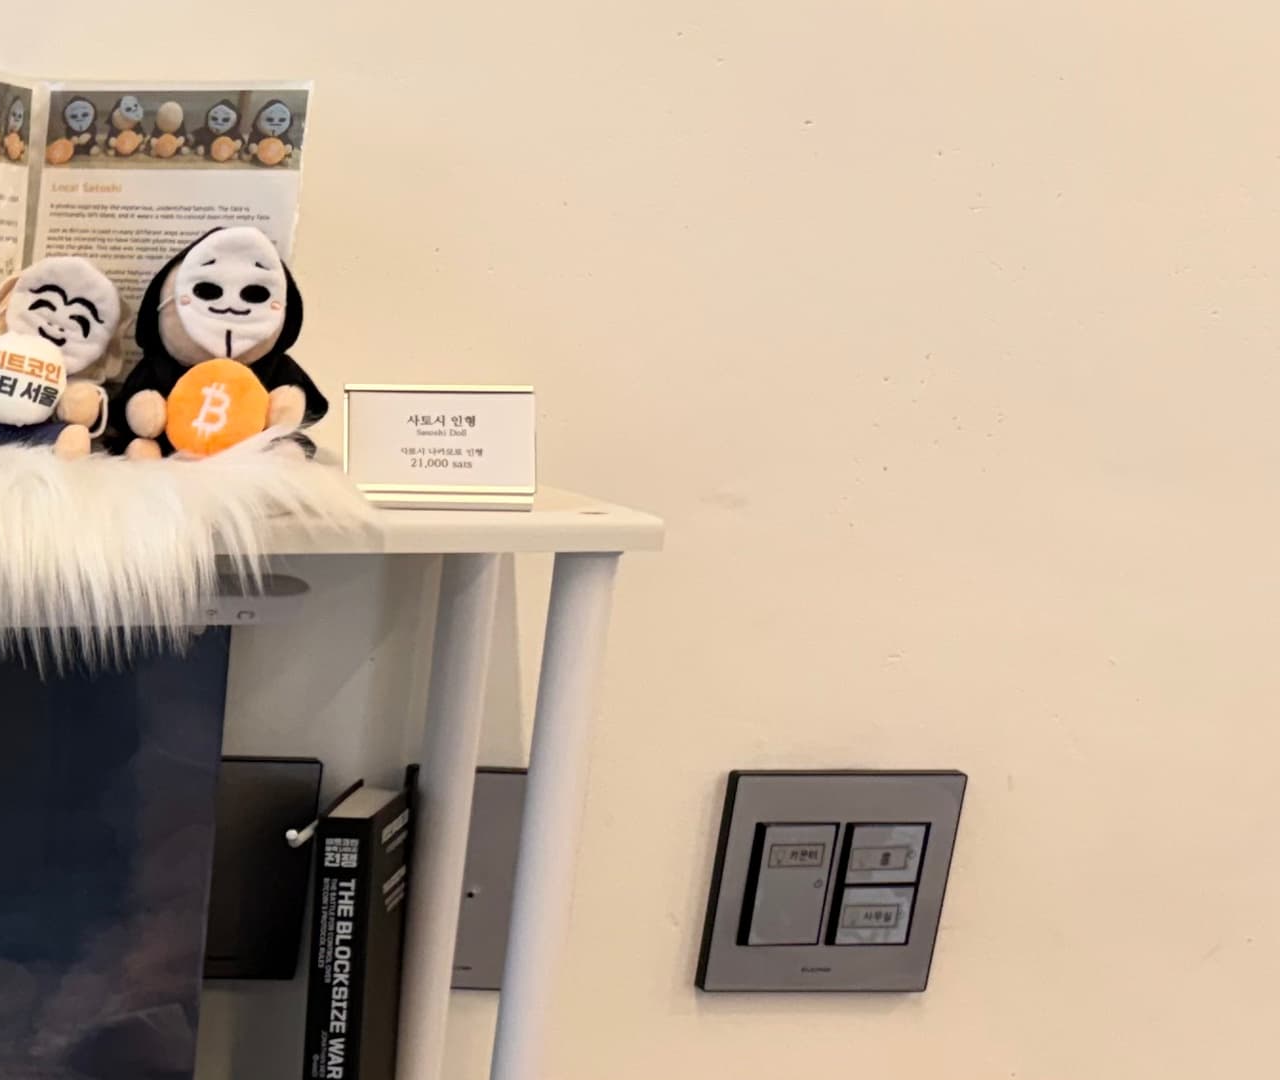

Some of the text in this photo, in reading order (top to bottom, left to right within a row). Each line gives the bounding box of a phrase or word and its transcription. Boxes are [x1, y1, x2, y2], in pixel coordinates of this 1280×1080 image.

[20, 381, 60, 408] 서울
[407, 414, 476, 428] 사토시 인형
[416, 428, 467, 437] Satoshi Doll
[410, 458, 473, 469] 21,000 sats
[863, 909, 893, 923] 사무실
[326, 878, 356, 1079] THE BLOCKSIZE WAR
